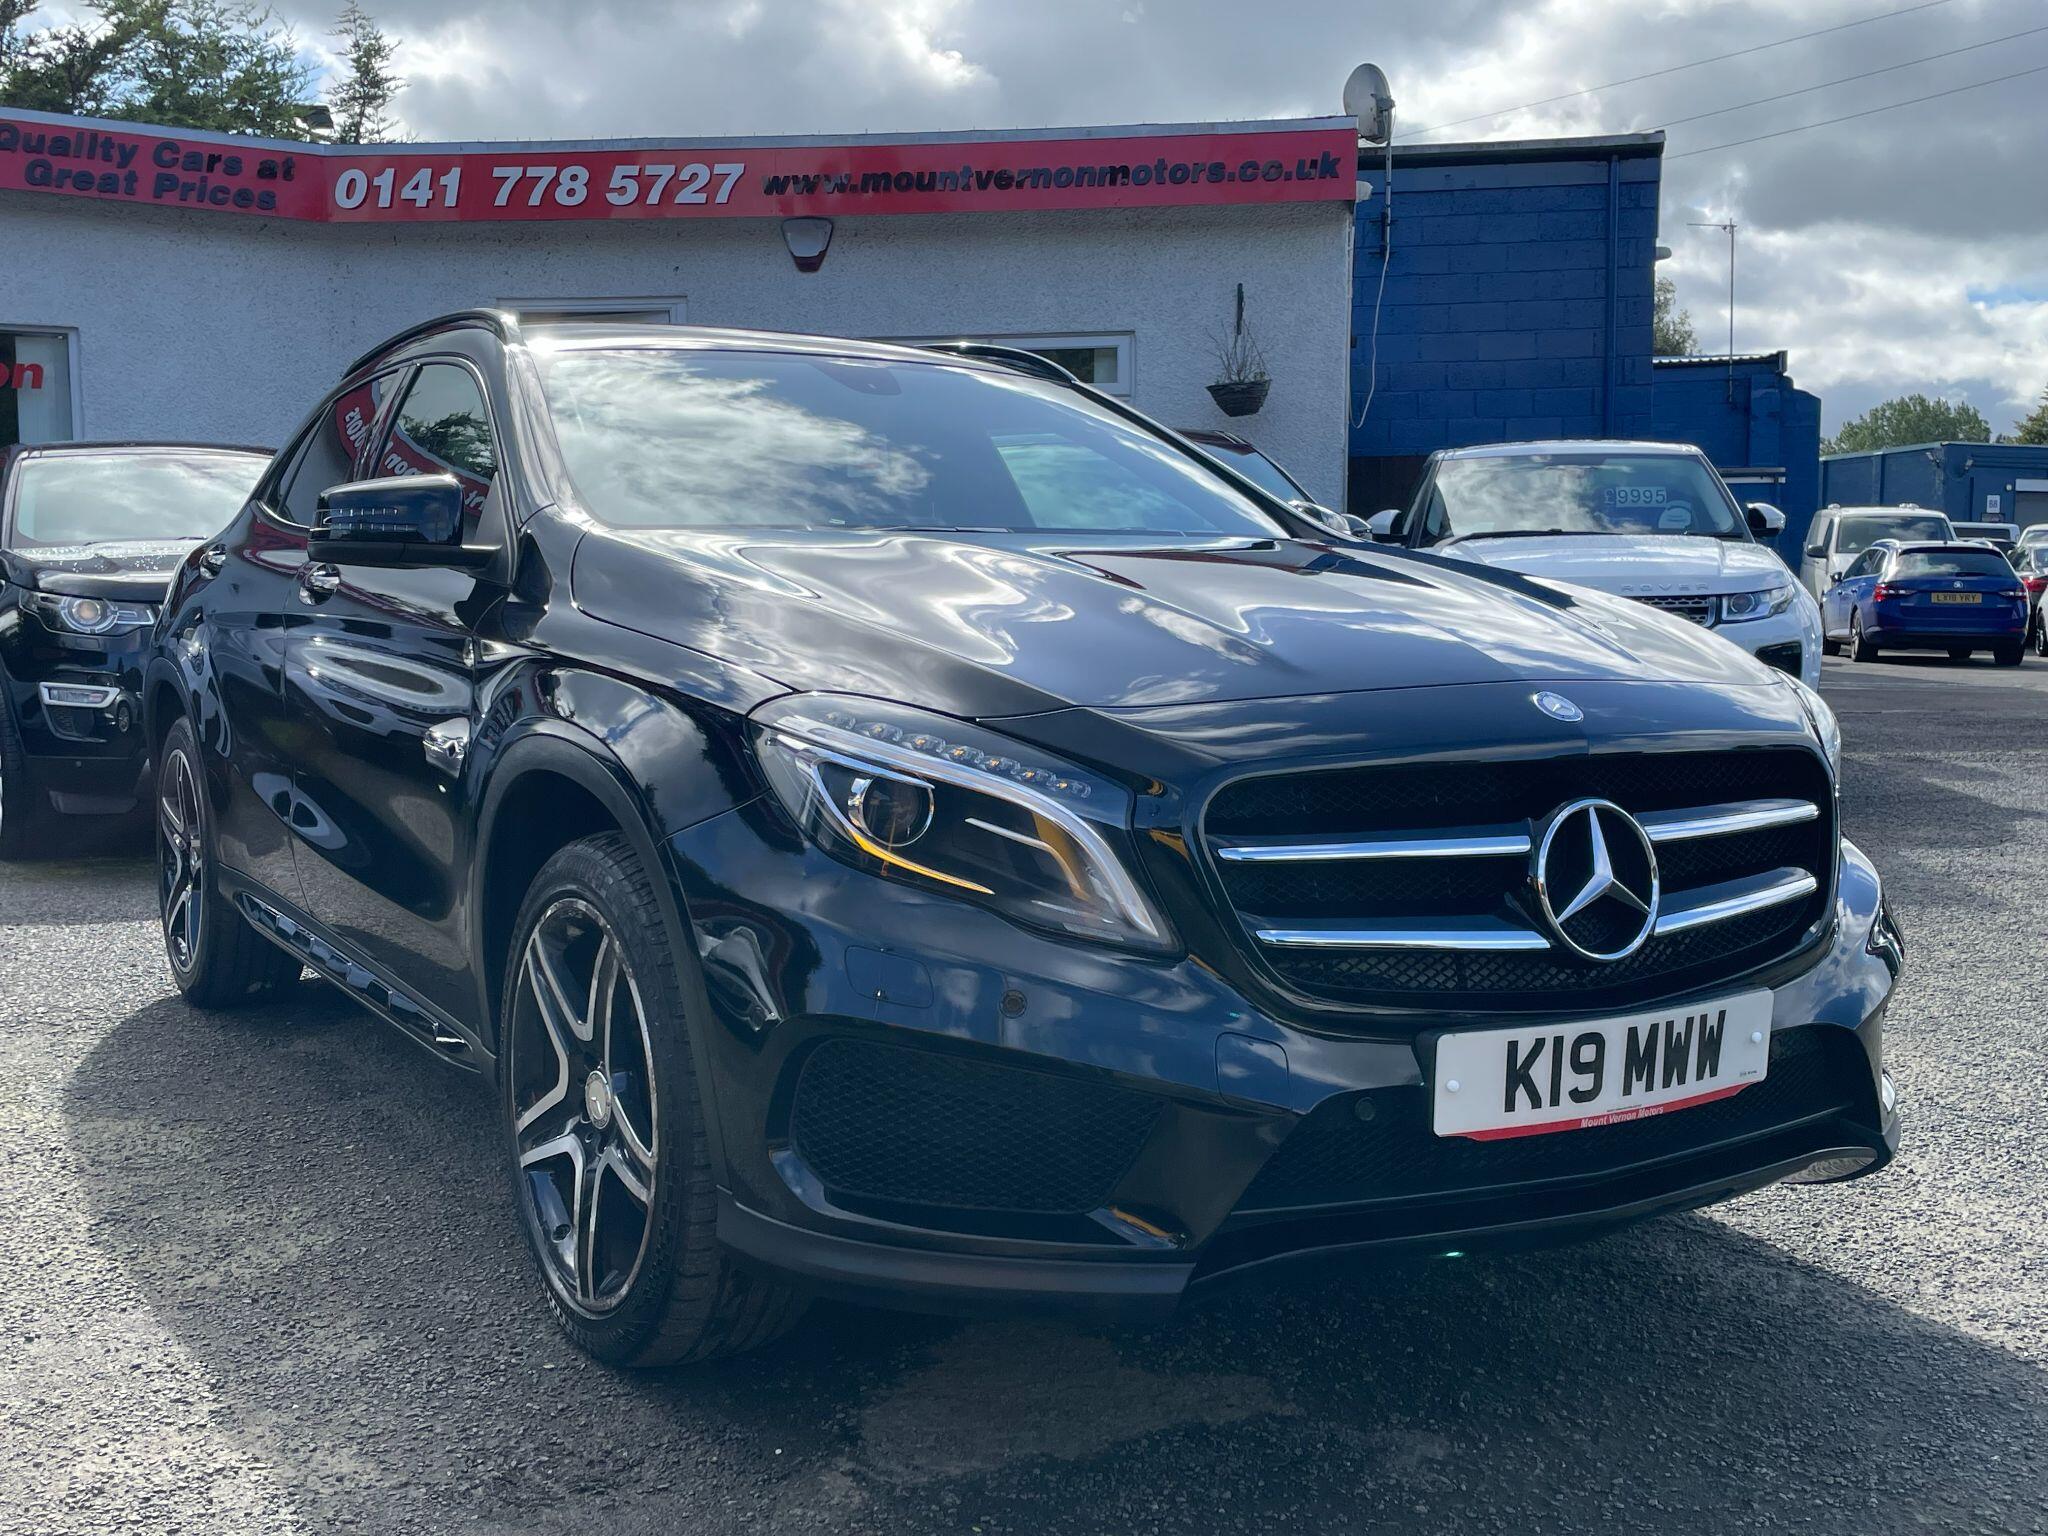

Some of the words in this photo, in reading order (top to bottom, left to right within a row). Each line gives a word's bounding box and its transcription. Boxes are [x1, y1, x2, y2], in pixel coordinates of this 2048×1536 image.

[0, 123, 139, 168] Quality
[153, 141, 242, 176] Cars
[257, 156, 295, 181] at
[762, 151, 1339, 195] www.mountvernonmotors.co.uk
[25, 159, 138, 195] Great
[153, 172, 276, 210] Prices
[334, 168, 461, 209] 0141
[492, 165, 590, 208] 778
[605, 163, 745, 206] 5727
[1621, 583, 1710, 592] ROVER
[1504, 1031, 1606, 1113] K19
[1622, 1009, 1727, 1097] MWW
[1580, 1115, 1608, 1129] Mount
[1609, 1111, 1637, 1124] Vernon
[1638, 1106, 1664, 1119] Motors
